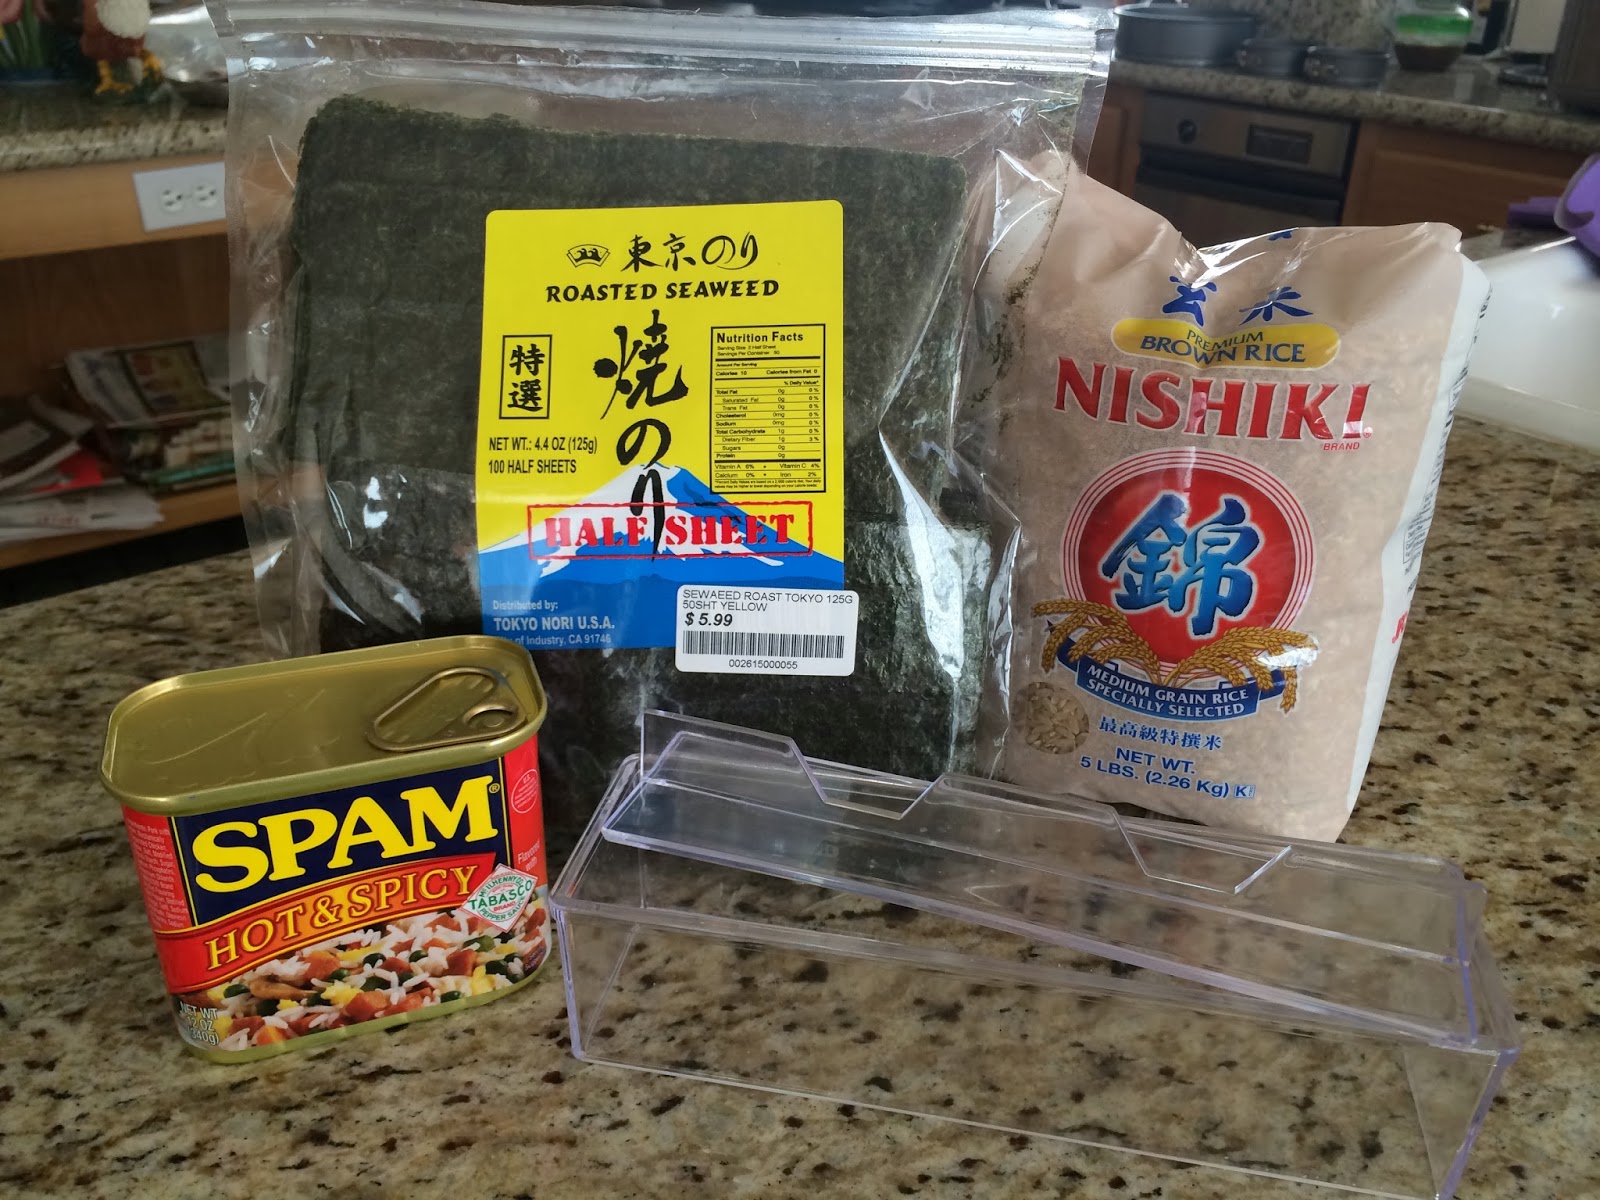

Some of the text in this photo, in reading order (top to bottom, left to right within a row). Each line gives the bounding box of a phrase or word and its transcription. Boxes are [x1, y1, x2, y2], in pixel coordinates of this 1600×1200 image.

[620, 231, 759, 273] 東京のり
[546, 279, 779, 303] ROASTED SEAWEED
[717, 331, 804, 343] Nutrition Facts
[1187, 329, 1264, 352] PREMIUM
[1140, 335, 1306, 365] BROWN RICE
[507, 343, 545, 413] 特選
[1053, 356, 1371, 440] NISHIKI
[489, 436, 598, 454] NET WT.: 4.4 OZ (125g)
[1323, 442, 1360, 451] BRAND
[488, 459, 577, 474] 100 HALF SHEETS
[544, 514, 795, 548] HALF SHEET
[1101, 493, 1261, 636] 錦
[492, 600, 558, 611] Distributed by:
[682, 590, 853, 604] SEWAEED ROAST TOKYO 125G
[682, 601, 768, 612] 50SHT YELLOW
[494, 616, 615, 632] TOKYO NORI U.S.A.
[684, 612, 733, 626] $ 5.99
[514, 636, 525, 645] of
[527, 635, 566, 646] Industry,
[568, 634, 583, 644] CA
[584, 634, 611, 644] 91746
[728, 659, 798, 670] 002615000055
[1087, 664, 1249, 705] MEDIUM GRAIN RICE
[1086, 678, 1245, 718] SPECIALLY SELECTED
[1099, 716, 1222, 750] 最高級特撰米
[1116, 748, 1196, 774] NET WT.
[1080, 756, 1091, 768] 5
[1096, 760, 1139, 780] LBS.
[1146, 770, 1190, 789] (2.26
[1196, 780, 1230, 798] Kg)
[192, 775, 499, 893] SPAM
[468, 880, 532, 910] TABASCO
[493, 901, 516, 912] BRAND
[205, 905, 304, 971] HOT
[310, 894, 342, 928] &
[350, 866, 478, 916] SPICY
[480, 896, 526, 920] PEPPER SAUCE
[180, 1001, 217, 1019] NET WT
[188, 1026, 219, 1046] (340g)
[200, 1020, 214, 1032] OZ
